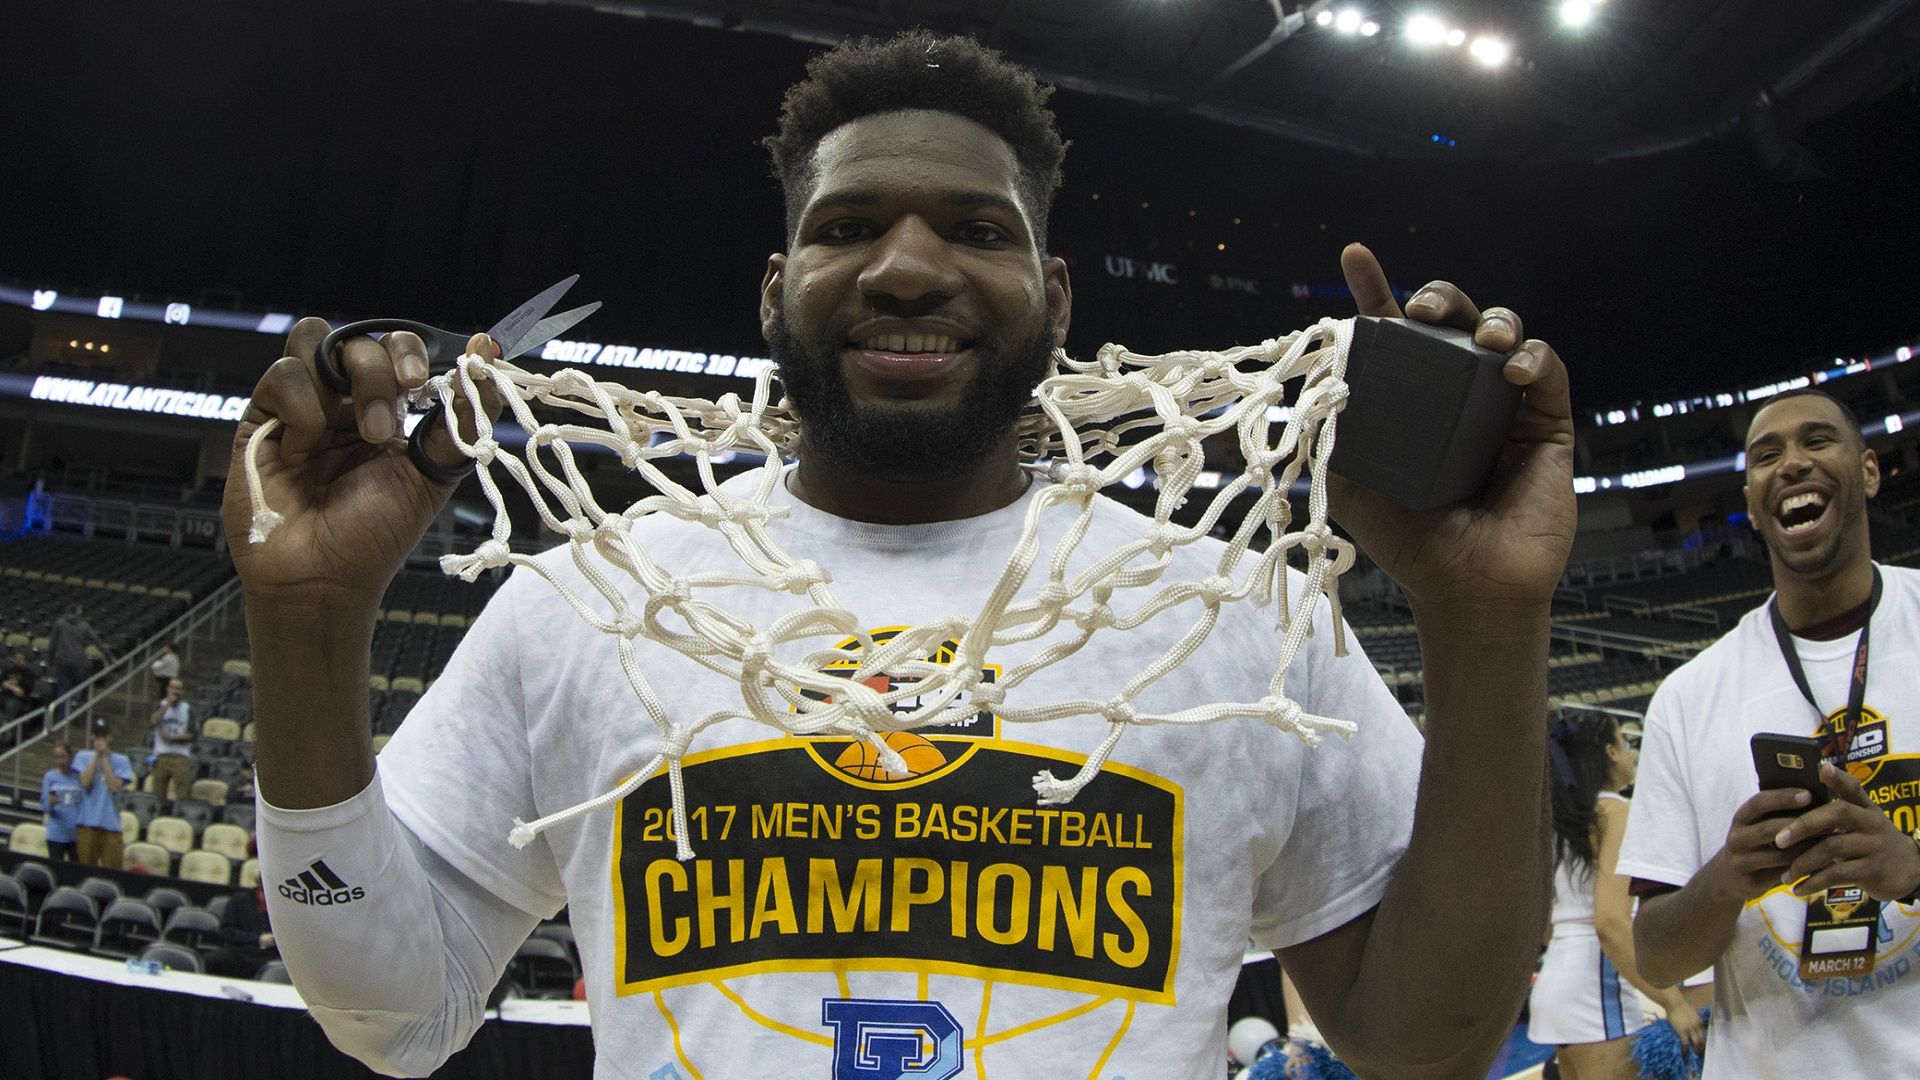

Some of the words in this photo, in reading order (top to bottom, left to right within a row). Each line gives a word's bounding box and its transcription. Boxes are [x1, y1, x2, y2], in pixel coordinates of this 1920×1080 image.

[541, 339, 602, 364] 2017
[596, 344, 707, 373] ATLANTIC
[704, 354, 737, 376] 10
[751, 802, 881, 840] MEN'S
[895, 802, 1153, 849] BASKETBALL
[278, 884, 366, 906] adidas
[644, 857, 1152, 968] CHAMPIONS
[1808, 959, 1850, 974] MARCH
[1854, 957, 1865, 970] 12
[1822, 957, 1910, 996] ISLAND
